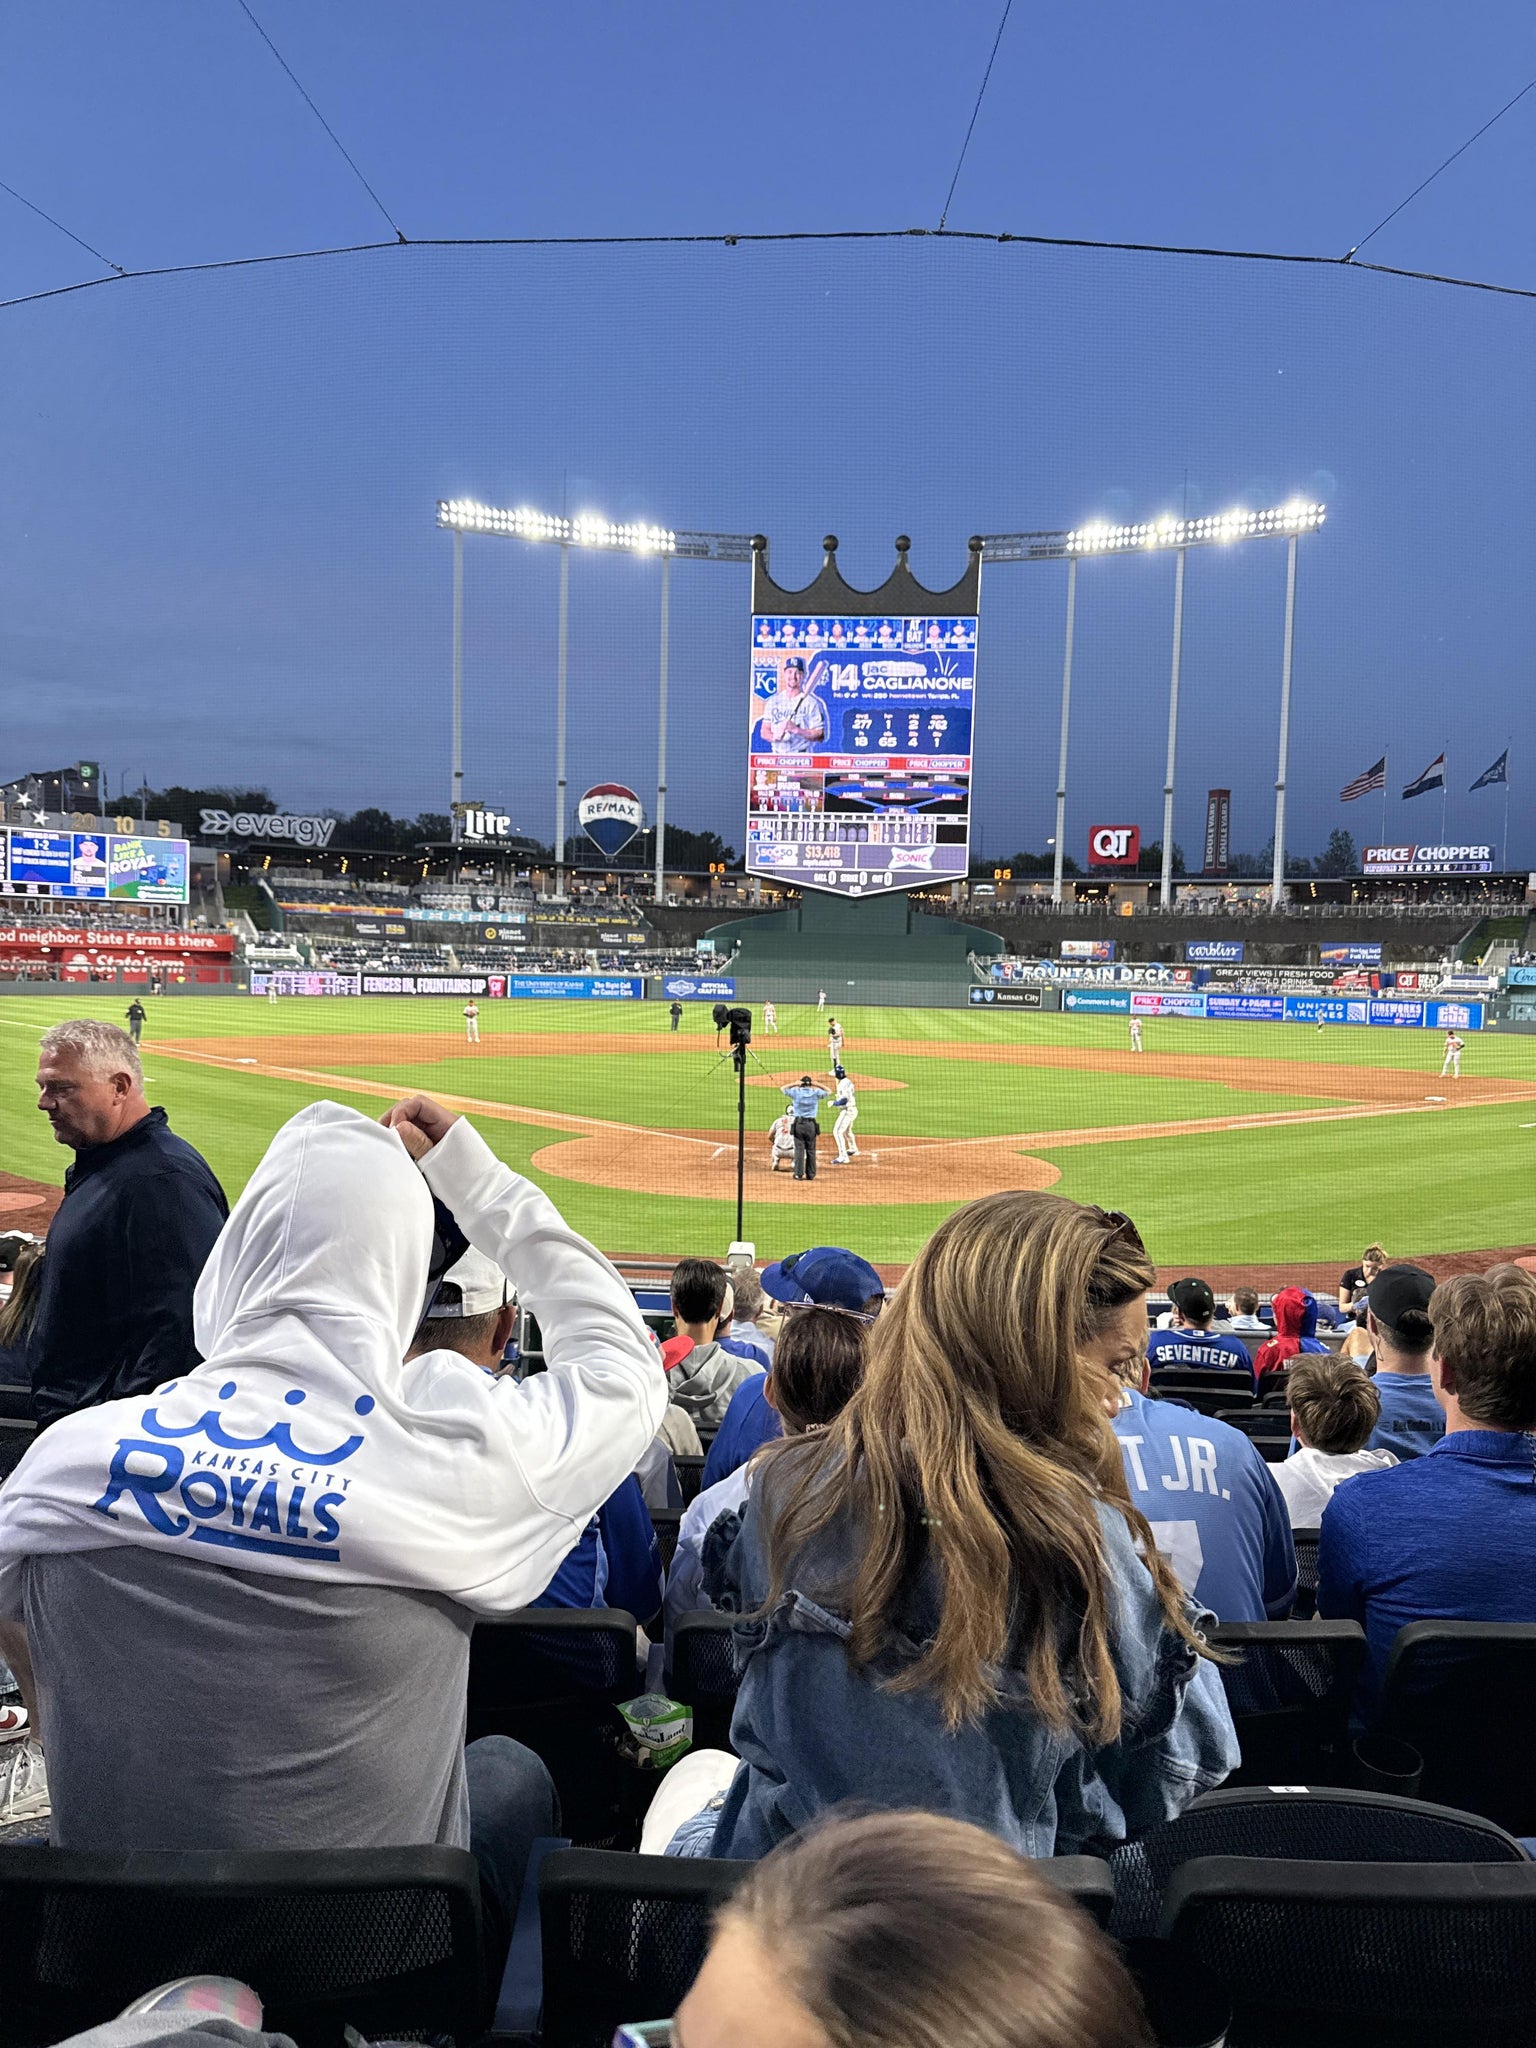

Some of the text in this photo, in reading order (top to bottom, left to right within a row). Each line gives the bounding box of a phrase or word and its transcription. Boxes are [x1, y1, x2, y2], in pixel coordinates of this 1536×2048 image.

[910, 620, 920, 631] AT
[866, 664, 887, 675] jac
[755, 672, 777, 694] KC
[829, 664, 860, 691] 14
[863, 677, 973, 690] CAGLIANONE
[886, 720, 891, 730] 1
[908, 720, 919, 730] 2
[854, 737, 940, 748] 18 65 4 1
[81, 766, 91, 777] 9
[587, 803, 634, 817] RE/MAX
[71, 811, 96, 831] 20
[113, 815, 134, 835] 10
[157, 819, 171, 837] 5
[464, 809, 511, 839] Lite
[235, 813, 335, 847] evergy
[1206, 803, 1217, 863] BOULEVARD
[1219, 803, 1229, 863] BOULEVARD
[113, 840, 143, 852] BANK
[1093, 830, 1135, 860] QT
[805, 846, 841, 860] $13,418
[895, 853, 928, 863] SONIC
[1366, 846, 1490, 862] PRICE CHOPPER
[109, 854, 158, 875] ROYAL
[499, 927, 521, 936] planet
[20, 931, 218, 948] neighbor, State Farm is there.
[1189, 942, 1241, 958] carbliss
[1022, 966, 1171, 982] FOUNTAIN DECK
[1216, 970, 1335, 980] GREAT VIEWS FRESH FOOD
[1399, 974, 1415, 987] QT
[364, 977, 401, 993] FENCES
[402, 978, 417, 994] IN,
[417, 978, 470, 994] FOUNTAINS
[471, 979, 486, 994] UP
[526, 980, 556, 988] UNIVERSITY
[1281, 977, 1314, 986] DRINKS
[997, 993, 1040, 1004] Kansas City
[1077, 997, 1128, 1007] Commerce Bank
[1136, 996, 1201, 1008] PRICE CHOPPER
[1209, 998, 1271, 1008] SUNDAY 4-PACK
[1297, 1002, 1344, 1012] UNITED
[1371, 1002, 1422, 1013] FIREWORKS
[1285, 1011, 1344, 1022] AIRLINES
[1371, 1012, 1394, 1020] EVERY
[1396, 1012, 1421, 1021] FRIDAY
[1156, 1344, 1239, 1369] SEVENTEEN
[191, 1450, 353, 1492] KANSAS CITY
[1161, 1435, 1232, 1502] JR.
[85, 1438, 347, 1543] ROYALS
